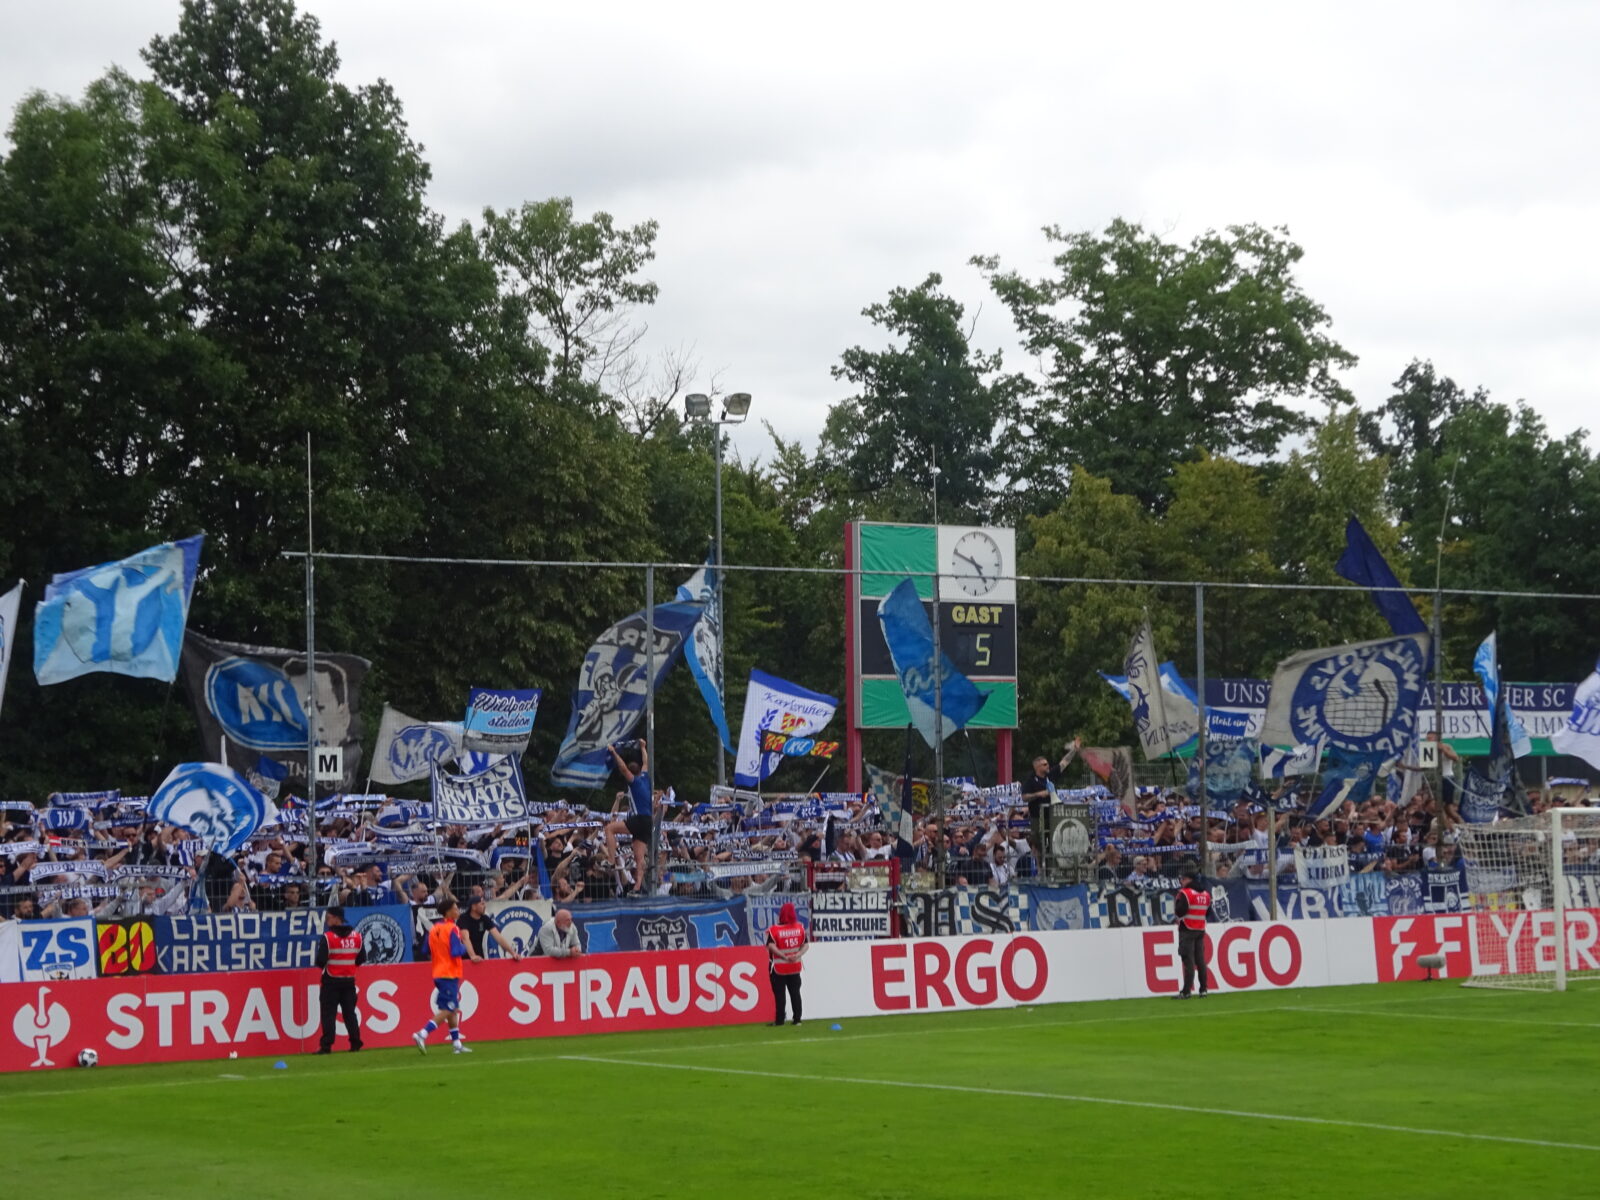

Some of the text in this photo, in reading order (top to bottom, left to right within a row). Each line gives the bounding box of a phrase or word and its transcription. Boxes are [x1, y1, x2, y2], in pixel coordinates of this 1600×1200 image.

[952, 606, 1003, 625] GAST
[975, 633, 991, 666] 5
[474, 693, 538, 715] Wildpark
[1543, 688, 1565, 707] SC
[488, 714, 531, 728] stadion
[319, 755, 337, 772] M
[1423, 748, 1434, 761] N
[438, 780, 519, 806] ARMATA
[437, 800, 525, 820] FIDELIS
[812, 891, 888, 910] WESTSIDE
[171, 910, 326, 941] CHAOTEN
[642, 922, 682, 935] ULTRAS
[812, 917, 888, 932] KARLSRUHE
[21, 927, 90, 971] ZS
[341, 939, 355, 948] 135
[157, 941, 318, 973] KARLSRUH
[871, 936, 1049, 1011] ERGO
[508, 962, 760, 1025] STRAUSS
[106, 980, 401, 1050] STRAUS
